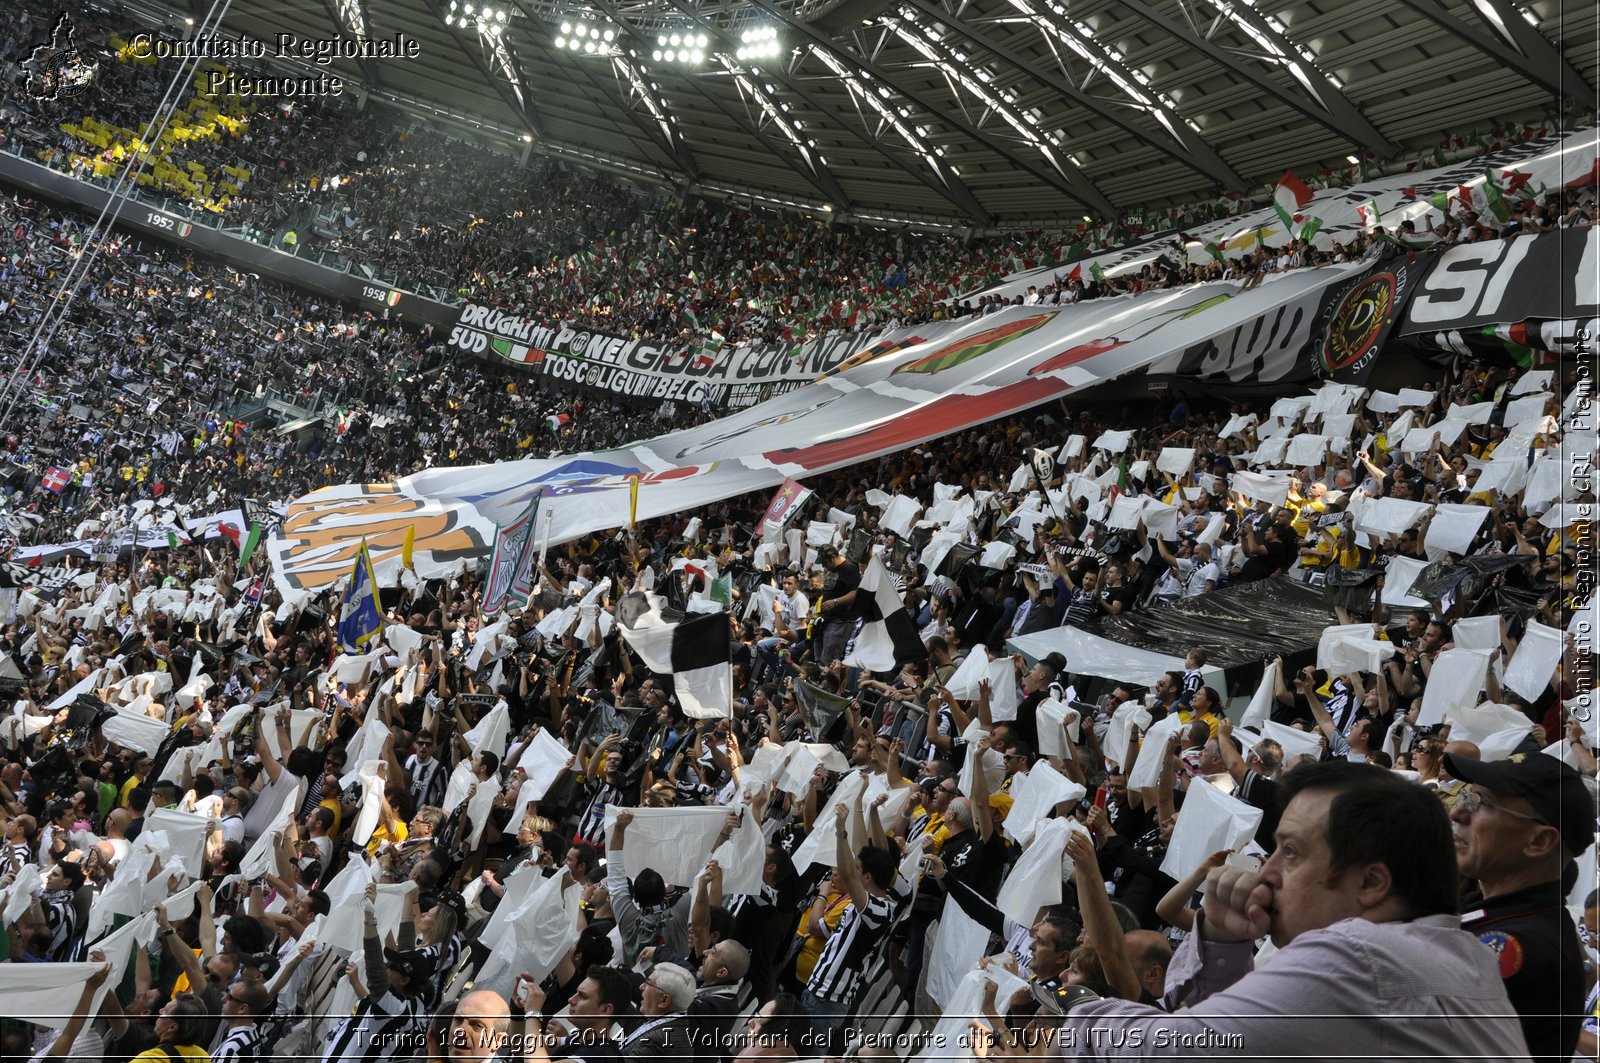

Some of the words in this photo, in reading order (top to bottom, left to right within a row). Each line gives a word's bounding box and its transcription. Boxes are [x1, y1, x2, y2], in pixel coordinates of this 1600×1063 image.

[147, 212, 175, 231] 1952
[1410, 232, 1540, 324] SI
[362, 285, 387, 301] 1958
[460, 303, 535, 341] DRUGHI
[448, 326, 487, 353] SUD
[1352, 345, 1378, 375] SUD
